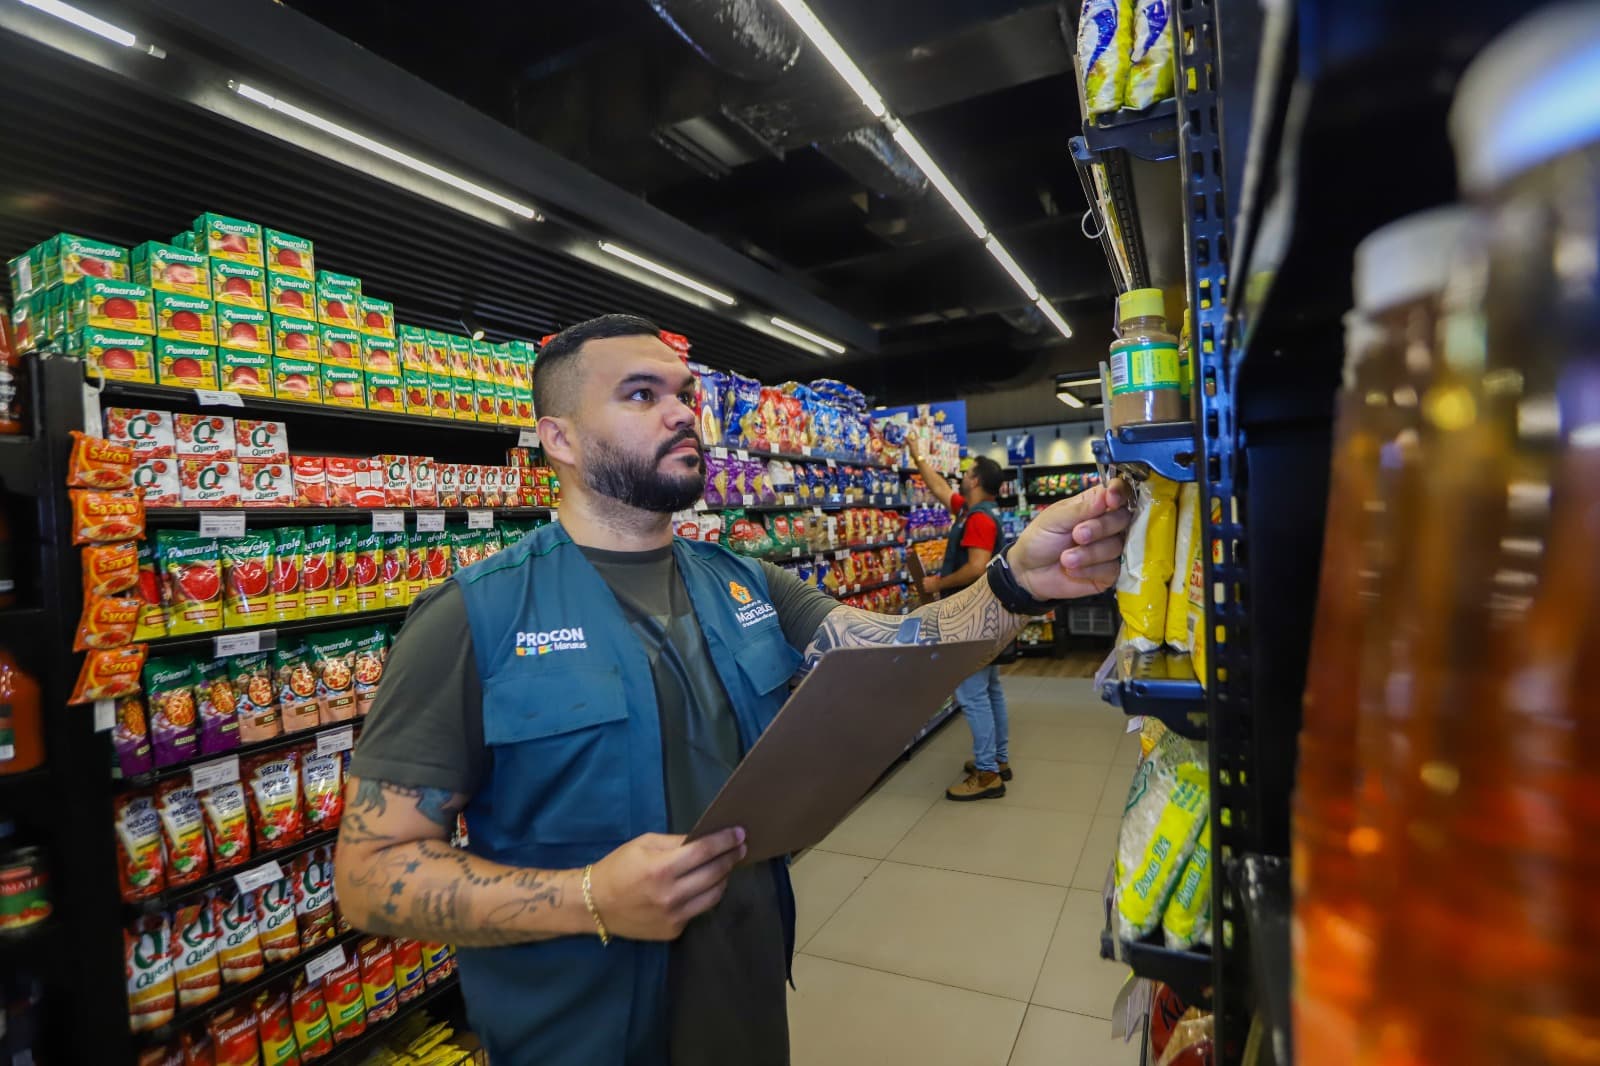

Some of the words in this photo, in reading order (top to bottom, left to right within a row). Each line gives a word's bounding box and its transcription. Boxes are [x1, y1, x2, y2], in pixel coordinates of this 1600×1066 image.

[212, 219, 257, 234] Pomarola
[271, 235, 308, 250] Pomarola
[70, 241, 122, 259] Pomarola
[157, 248, 203, 264] Pomarola
[218, 263, 260, 278] Pomarola
[275, 277, 311, 290] Pomarola
[326, 276, 357, 288] Pomarola
[94, 282, 146, 298] Pomarola
[320, 289, 353, 301] Pomarola
[164, 297, 210, 312] Pomarola
[224, 308, 264, 322] Pomarola
[279, 320, 315, 332] Pomarola
[93, 334, 145, 348] Pomarola
[325, 330, 358, 340] Pomarola
[164, 344, 210, 357] Pomarola
[365, 338, 395, 349] Pomarola
[224, 353, 267, 366] Pomarola
[279, 362, 315, 374] Pomarola
[326, 369, 359, 380] Pomarola
[371, 376, 399, 386] Pomarola
[193, 420, 217, 444] Q
[251, 425, 274, 448] Q
[136, 440, 158, 449] uero
[192, 443, 221, 454] Quero
[251, 447, 276, 457] Quero
[199, 466, 223, 490] Q
[255, 469, 279, 491] Q
[198, 490, 225, 500] Quero
[254, 491, 280, 500] Quero
[357, 534, 380, 547] arola
[427, 530, 449, 543] arola
[222, 540, 271, 555] Pomarola
[275, 537, 301, 553] arola
[304, 536, 331, 552] arola
[735, 603, 774, 624] Manaus
[515, 627, 585, 647] PROCON
[553, 641, 588, 651] Manaus
[261, 763, 290, 777] HEINZ
[1134, 860, 1161, 900] Dona
[1176, 867, 1202, 910] Dona
[226, 919, 259, 947] Quero
